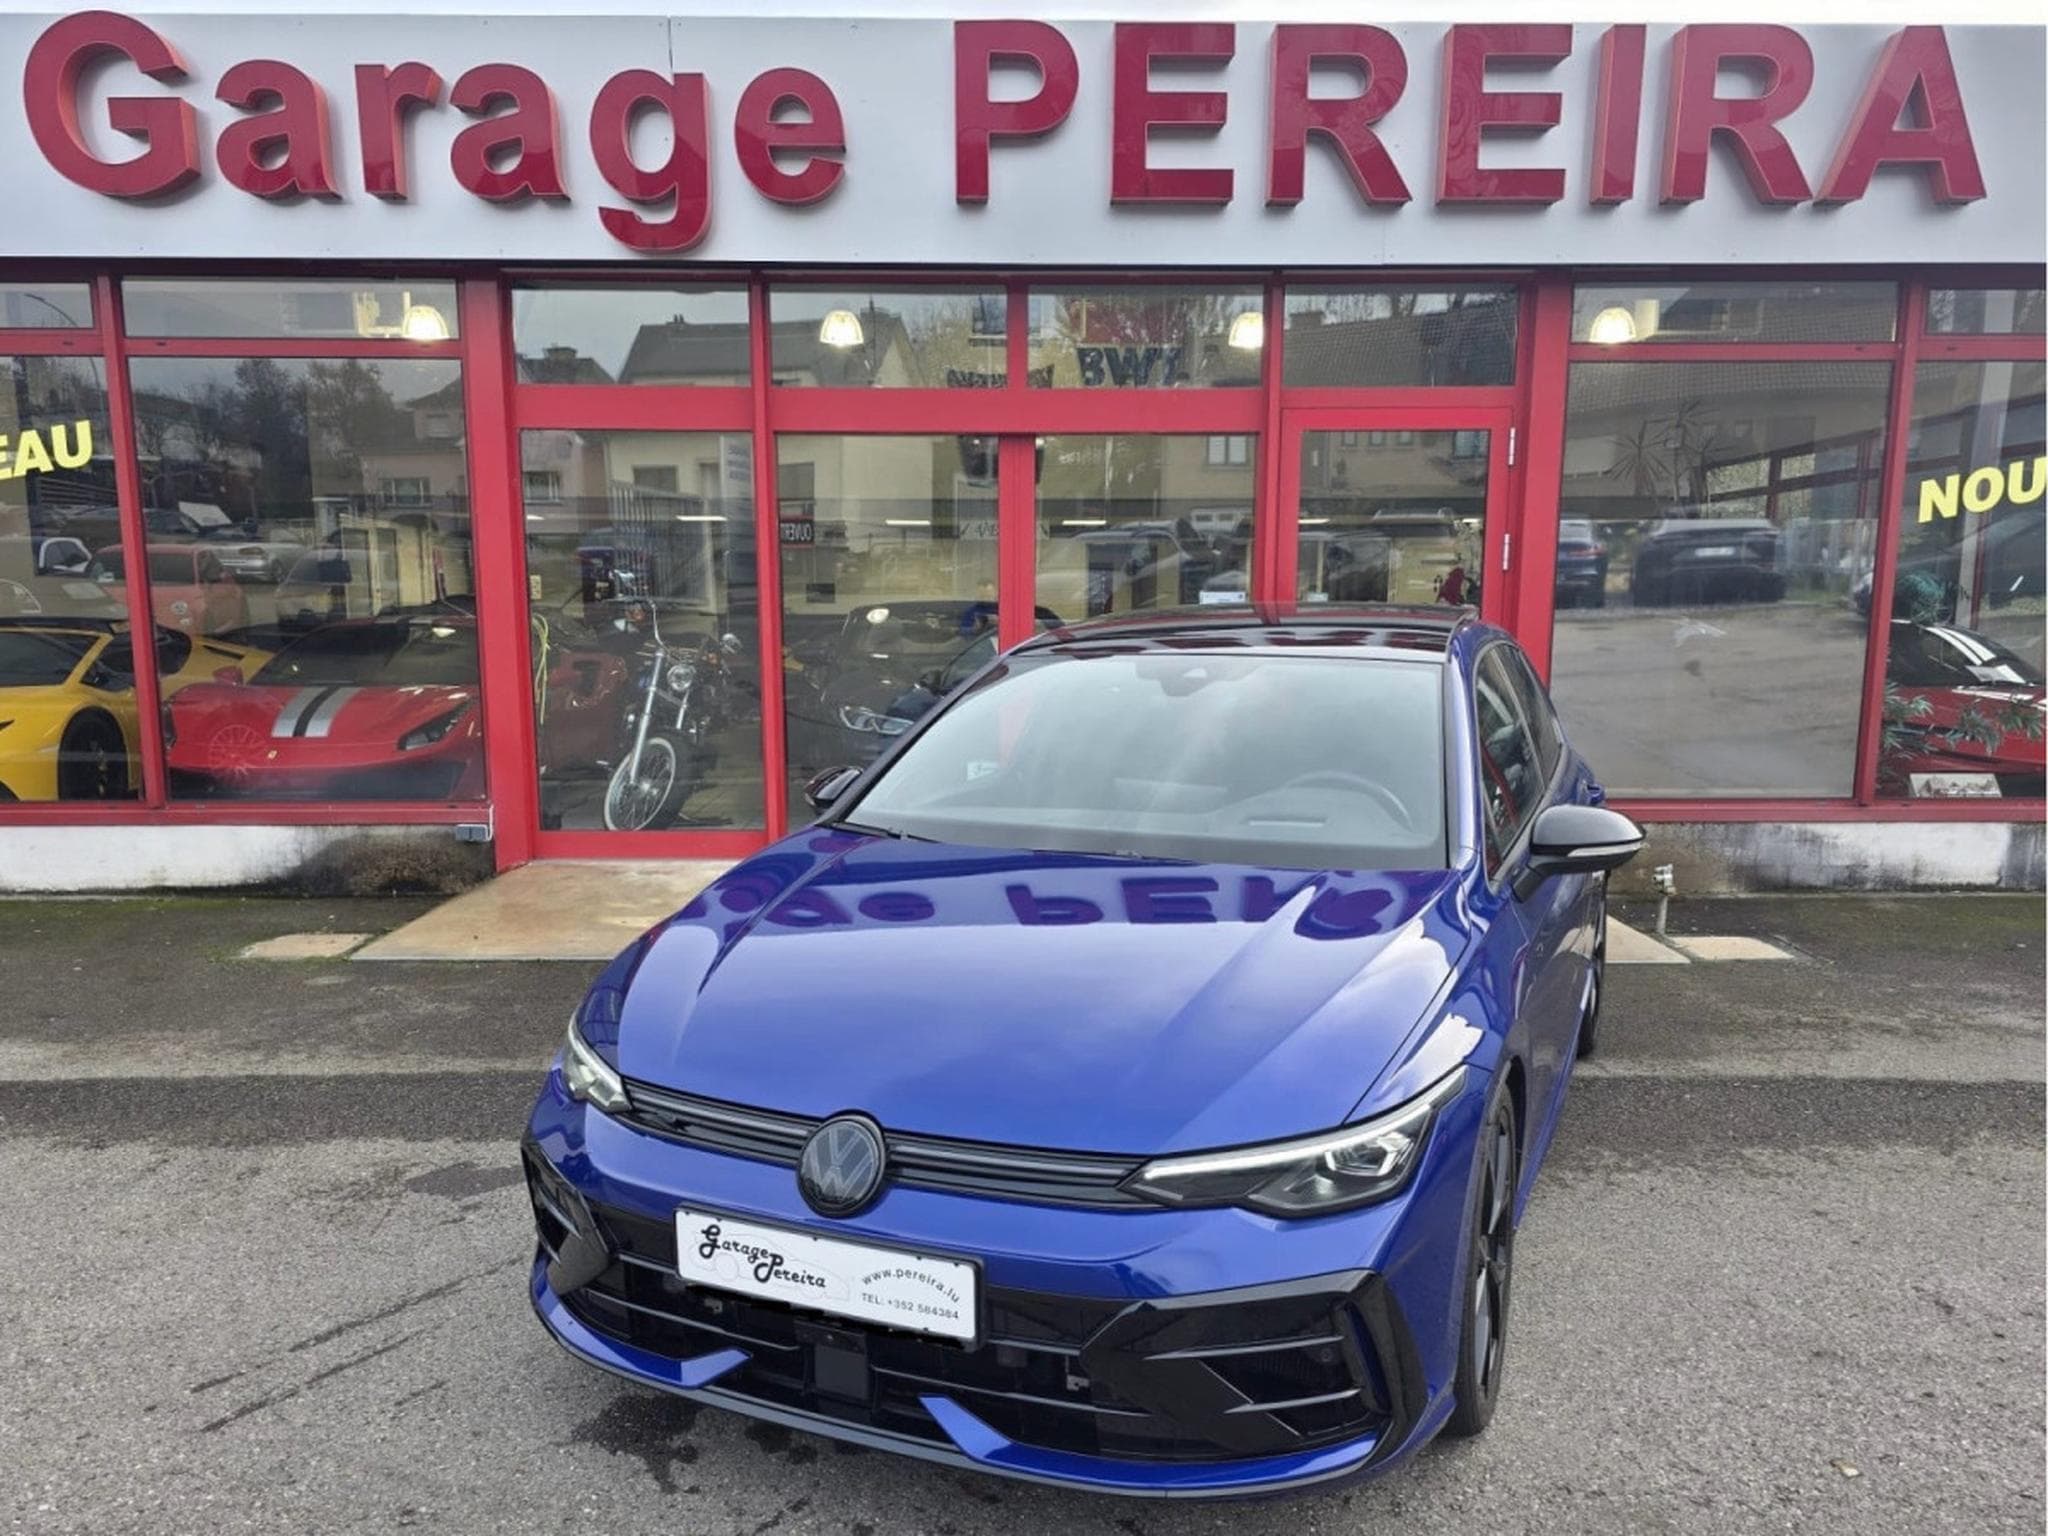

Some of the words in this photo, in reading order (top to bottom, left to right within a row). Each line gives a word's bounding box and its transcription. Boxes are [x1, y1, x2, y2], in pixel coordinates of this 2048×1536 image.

[24, 10, 848, 252] Garage
[954, 20, 1987, 206] PEREIRA
[699, 1224, 769, 1264] Garage
[753, 1253, 827, 1288] Pereira
[861, 1268, 960, 1303] www.pereira.lu
